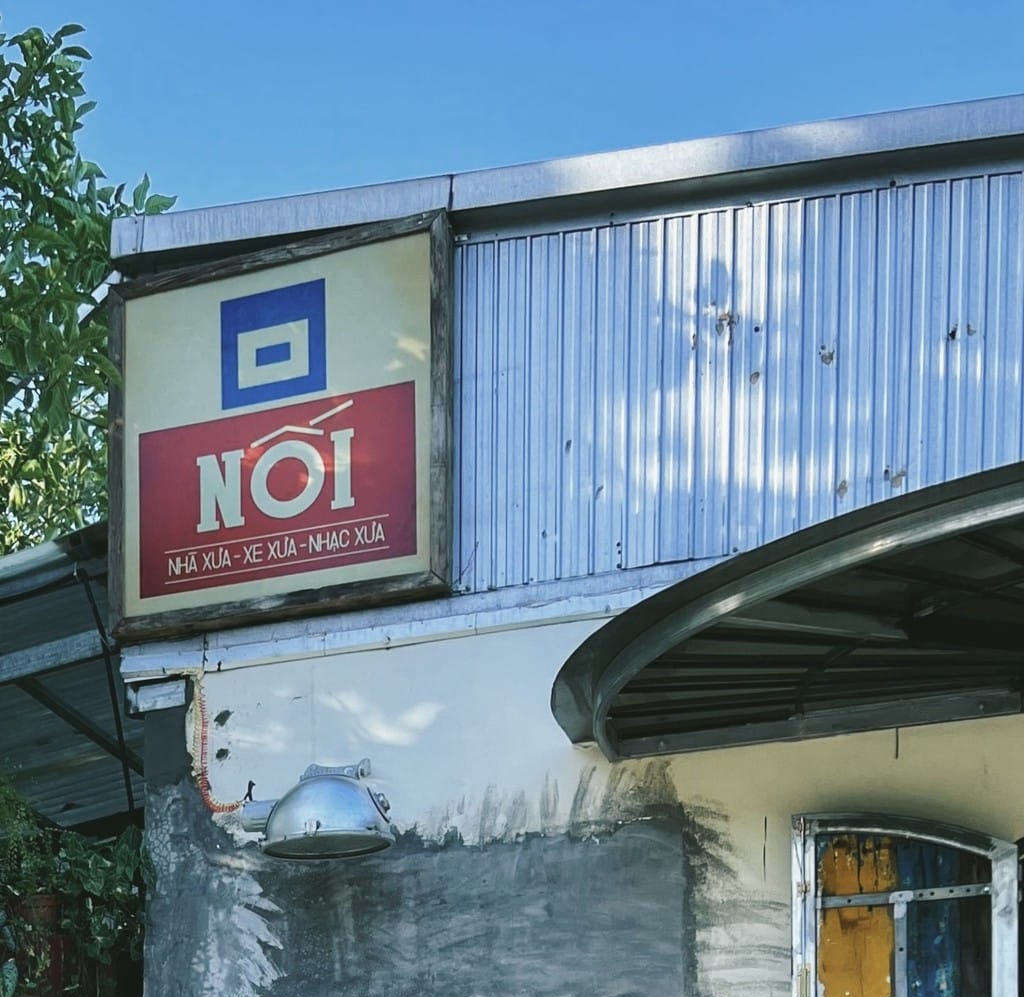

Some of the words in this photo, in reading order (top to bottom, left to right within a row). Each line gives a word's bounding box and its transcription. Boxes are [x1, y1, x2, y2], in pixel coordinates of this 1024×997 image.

[196, 398, 355, 533] NỐI
[202, 547, 232, 571] XƯA
[243, 543, 263, 564] XE
[267, 536, 297, 560] XƯA
[309, 529, 350, 553] NHẠC
[354, 521, 385, 546] XƯA
